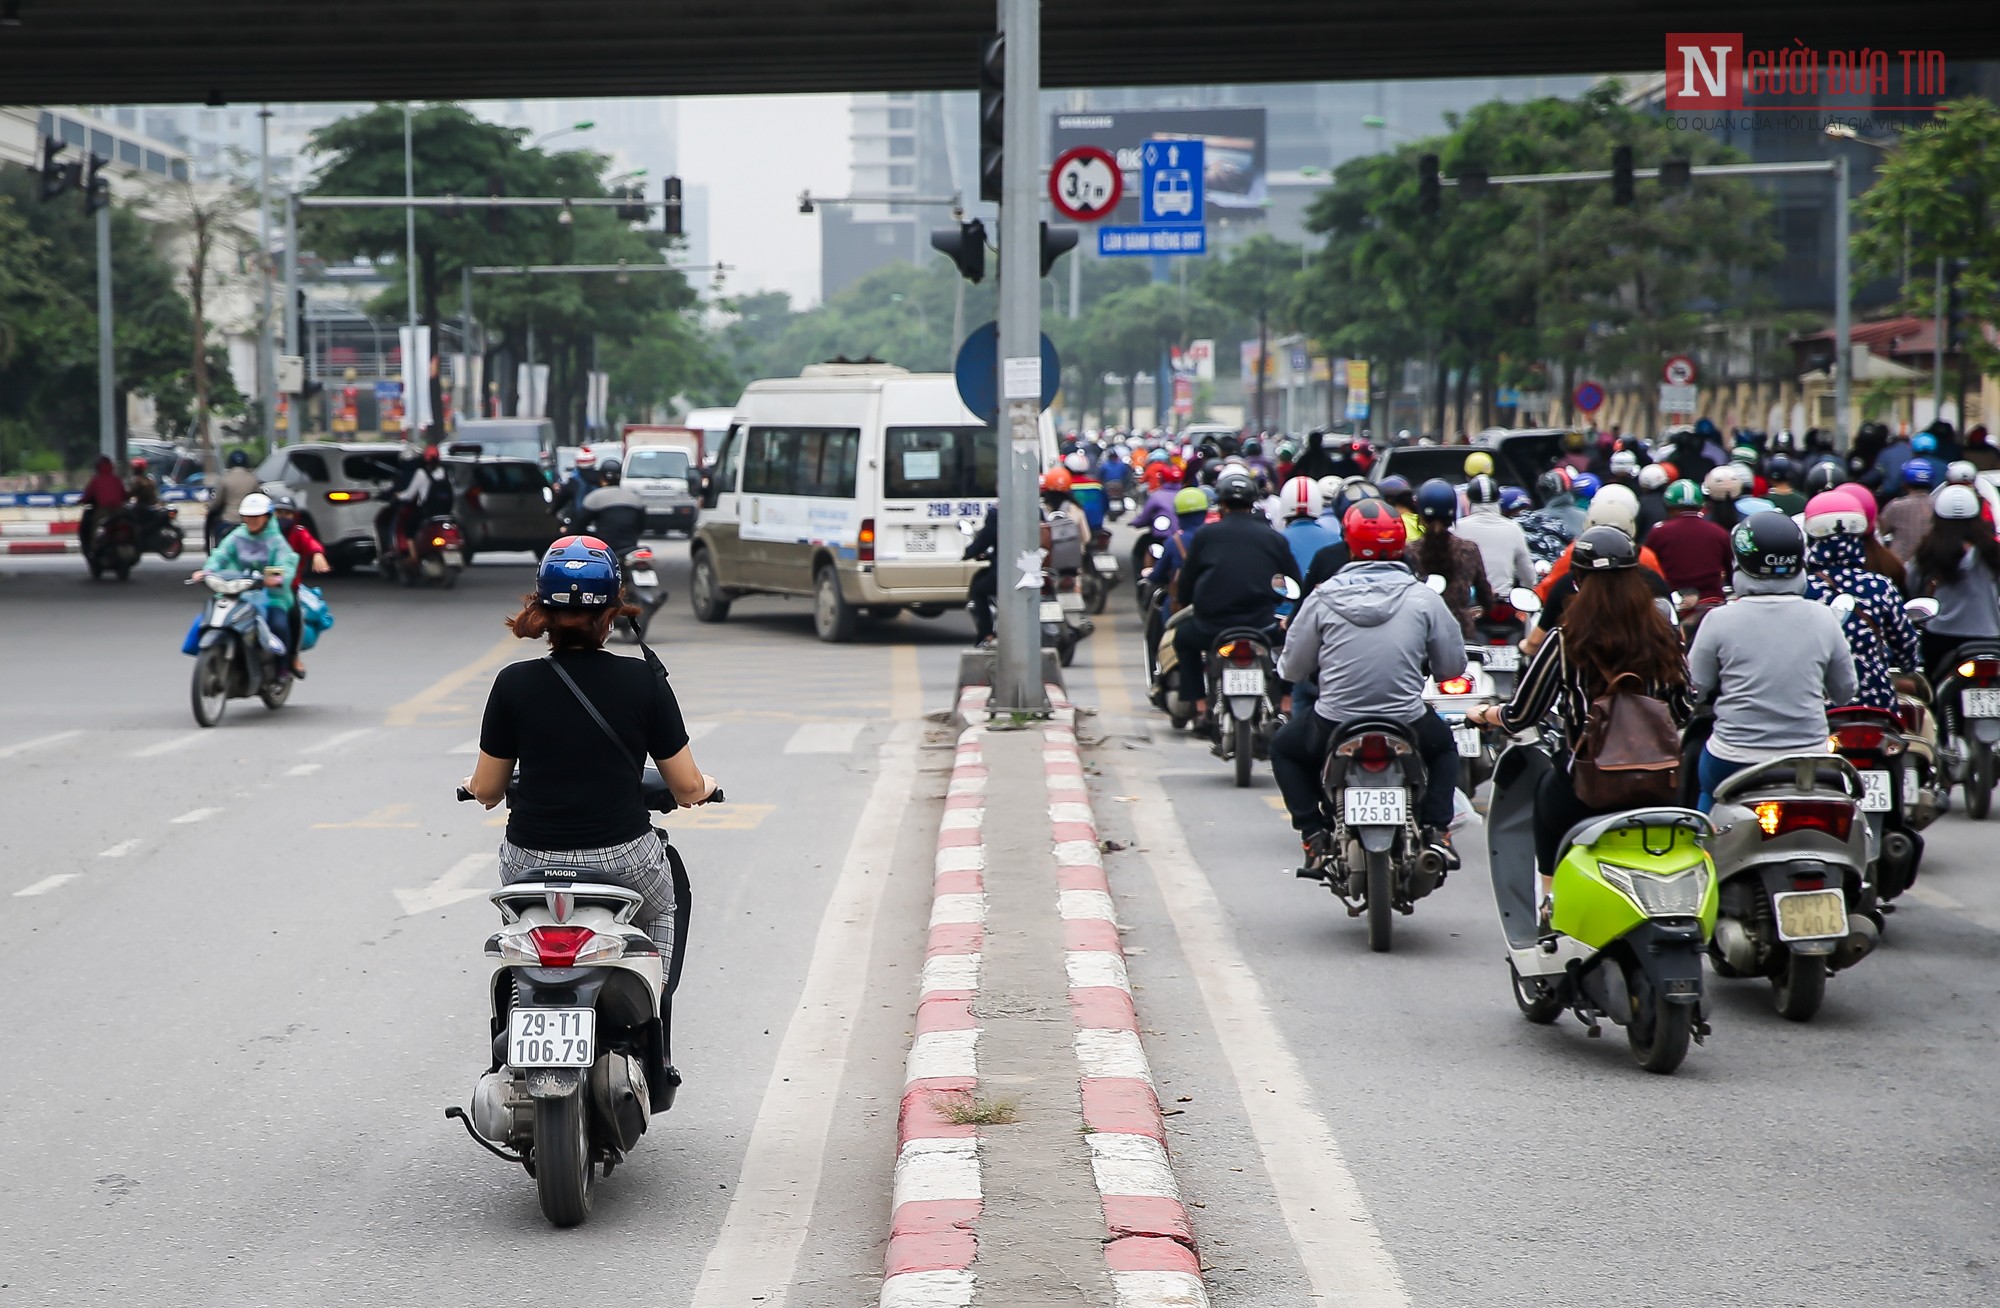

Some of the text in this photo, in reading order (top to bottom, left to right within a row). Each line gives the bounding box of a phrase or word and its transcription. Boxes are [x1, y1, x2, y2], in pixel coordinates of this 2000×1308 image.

[1765, 554, 1798, 566] CLEAR
[1356, 791, 1396, 805] 17-B3
[1350, 807, 1401, 822] 125.81
[544, 870, 577, 878] PIAGGIO
[522, 1013, 581, 1036] 29-T1
[516, 1039, 588, 1062] 106.79
